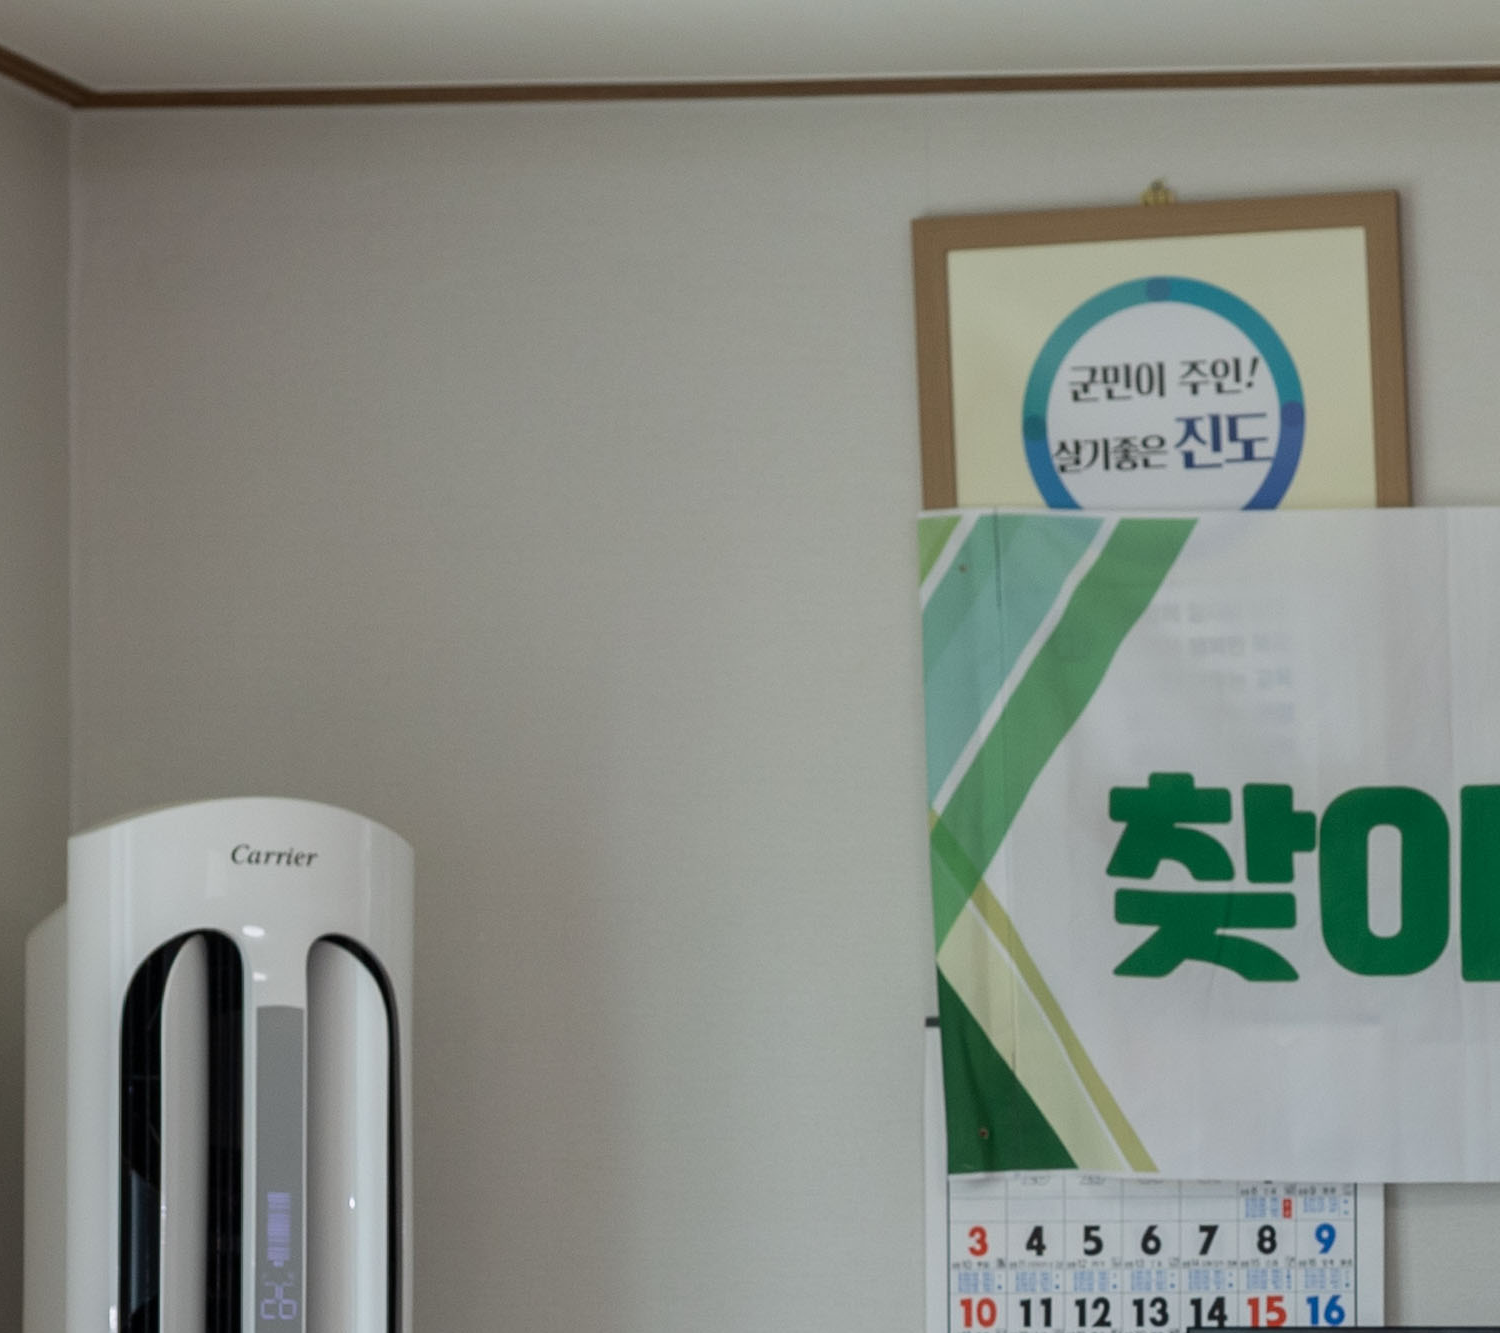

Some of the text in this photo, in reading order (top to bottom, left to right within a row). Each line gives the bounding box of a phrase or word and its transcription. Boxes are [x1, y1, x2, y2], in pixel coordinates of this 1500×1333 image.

[1067, 355, 1261, 403] 군민이 주인!
[1052, 412, 1275, 474] 살기좋은 진도
[230, 843, 319, 868] Carrier
[967, 1222, 1337, 1257] 3 4 5 6 7 8 9
[959, 1294, 1346, 1328] 10 11 12 13 14 15 16
